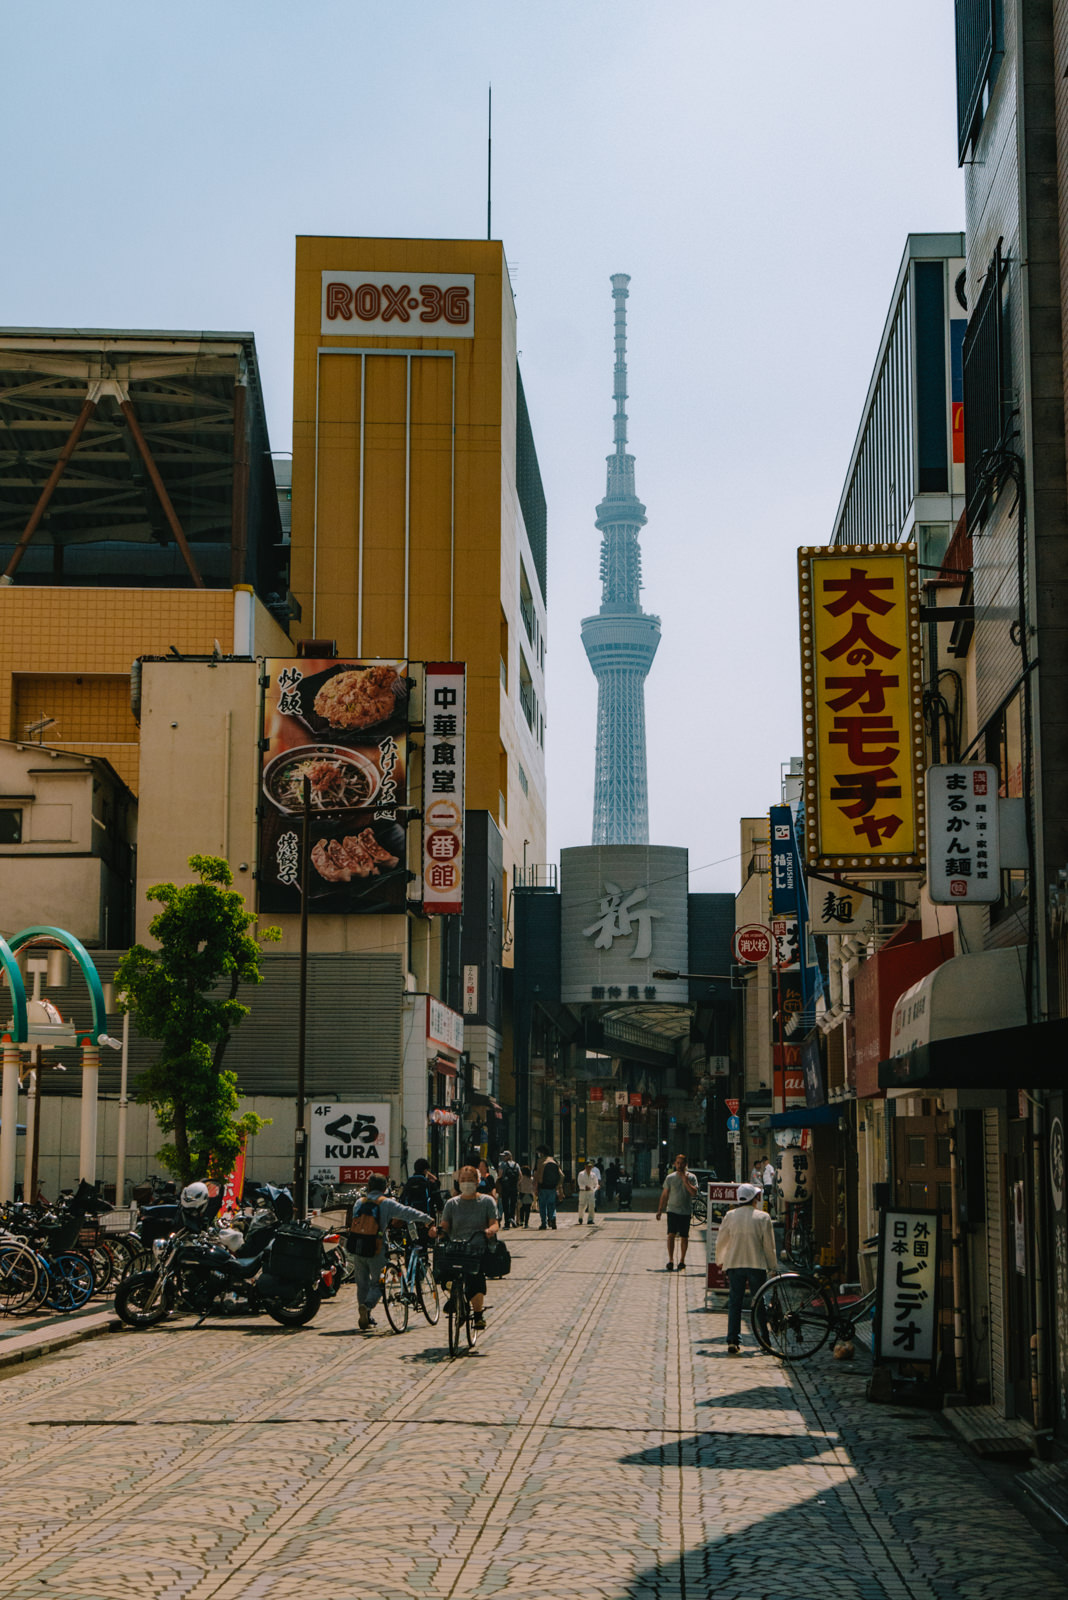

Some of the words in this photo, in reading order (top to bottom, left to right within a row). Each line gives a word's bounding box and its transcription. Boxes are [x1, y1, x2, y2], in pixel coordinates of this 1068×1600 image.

[278, 667, 302, 715] 炒飯
[820, 567, 903, 848] 大人のオモチャ
[432, 686, 457, 794] 中華食堂
[945, 773, 972, 877] まるかん麺
[277, 831, 298, 885] 焼餃子
[431, 813, 455, 887] 一番館
[774, 853, 786, 889] 福しん
[786, 852, 794, 889] FUKUSHIN
[582, 881, 664, 960] 新
[821, 891, 855, 924] 麺
[740, 938, 768, 953] 消火栓
[314, 1105, 331, 1116] 4F
[324, 1113, 379, 1144] くら
[325, 1144, 379, 1159] KURA
[891, 1221, 908, 1256] 日本
[913, 1221, 930, 1258] 外国
[892, 1260, 928, 1351] ビデオ
